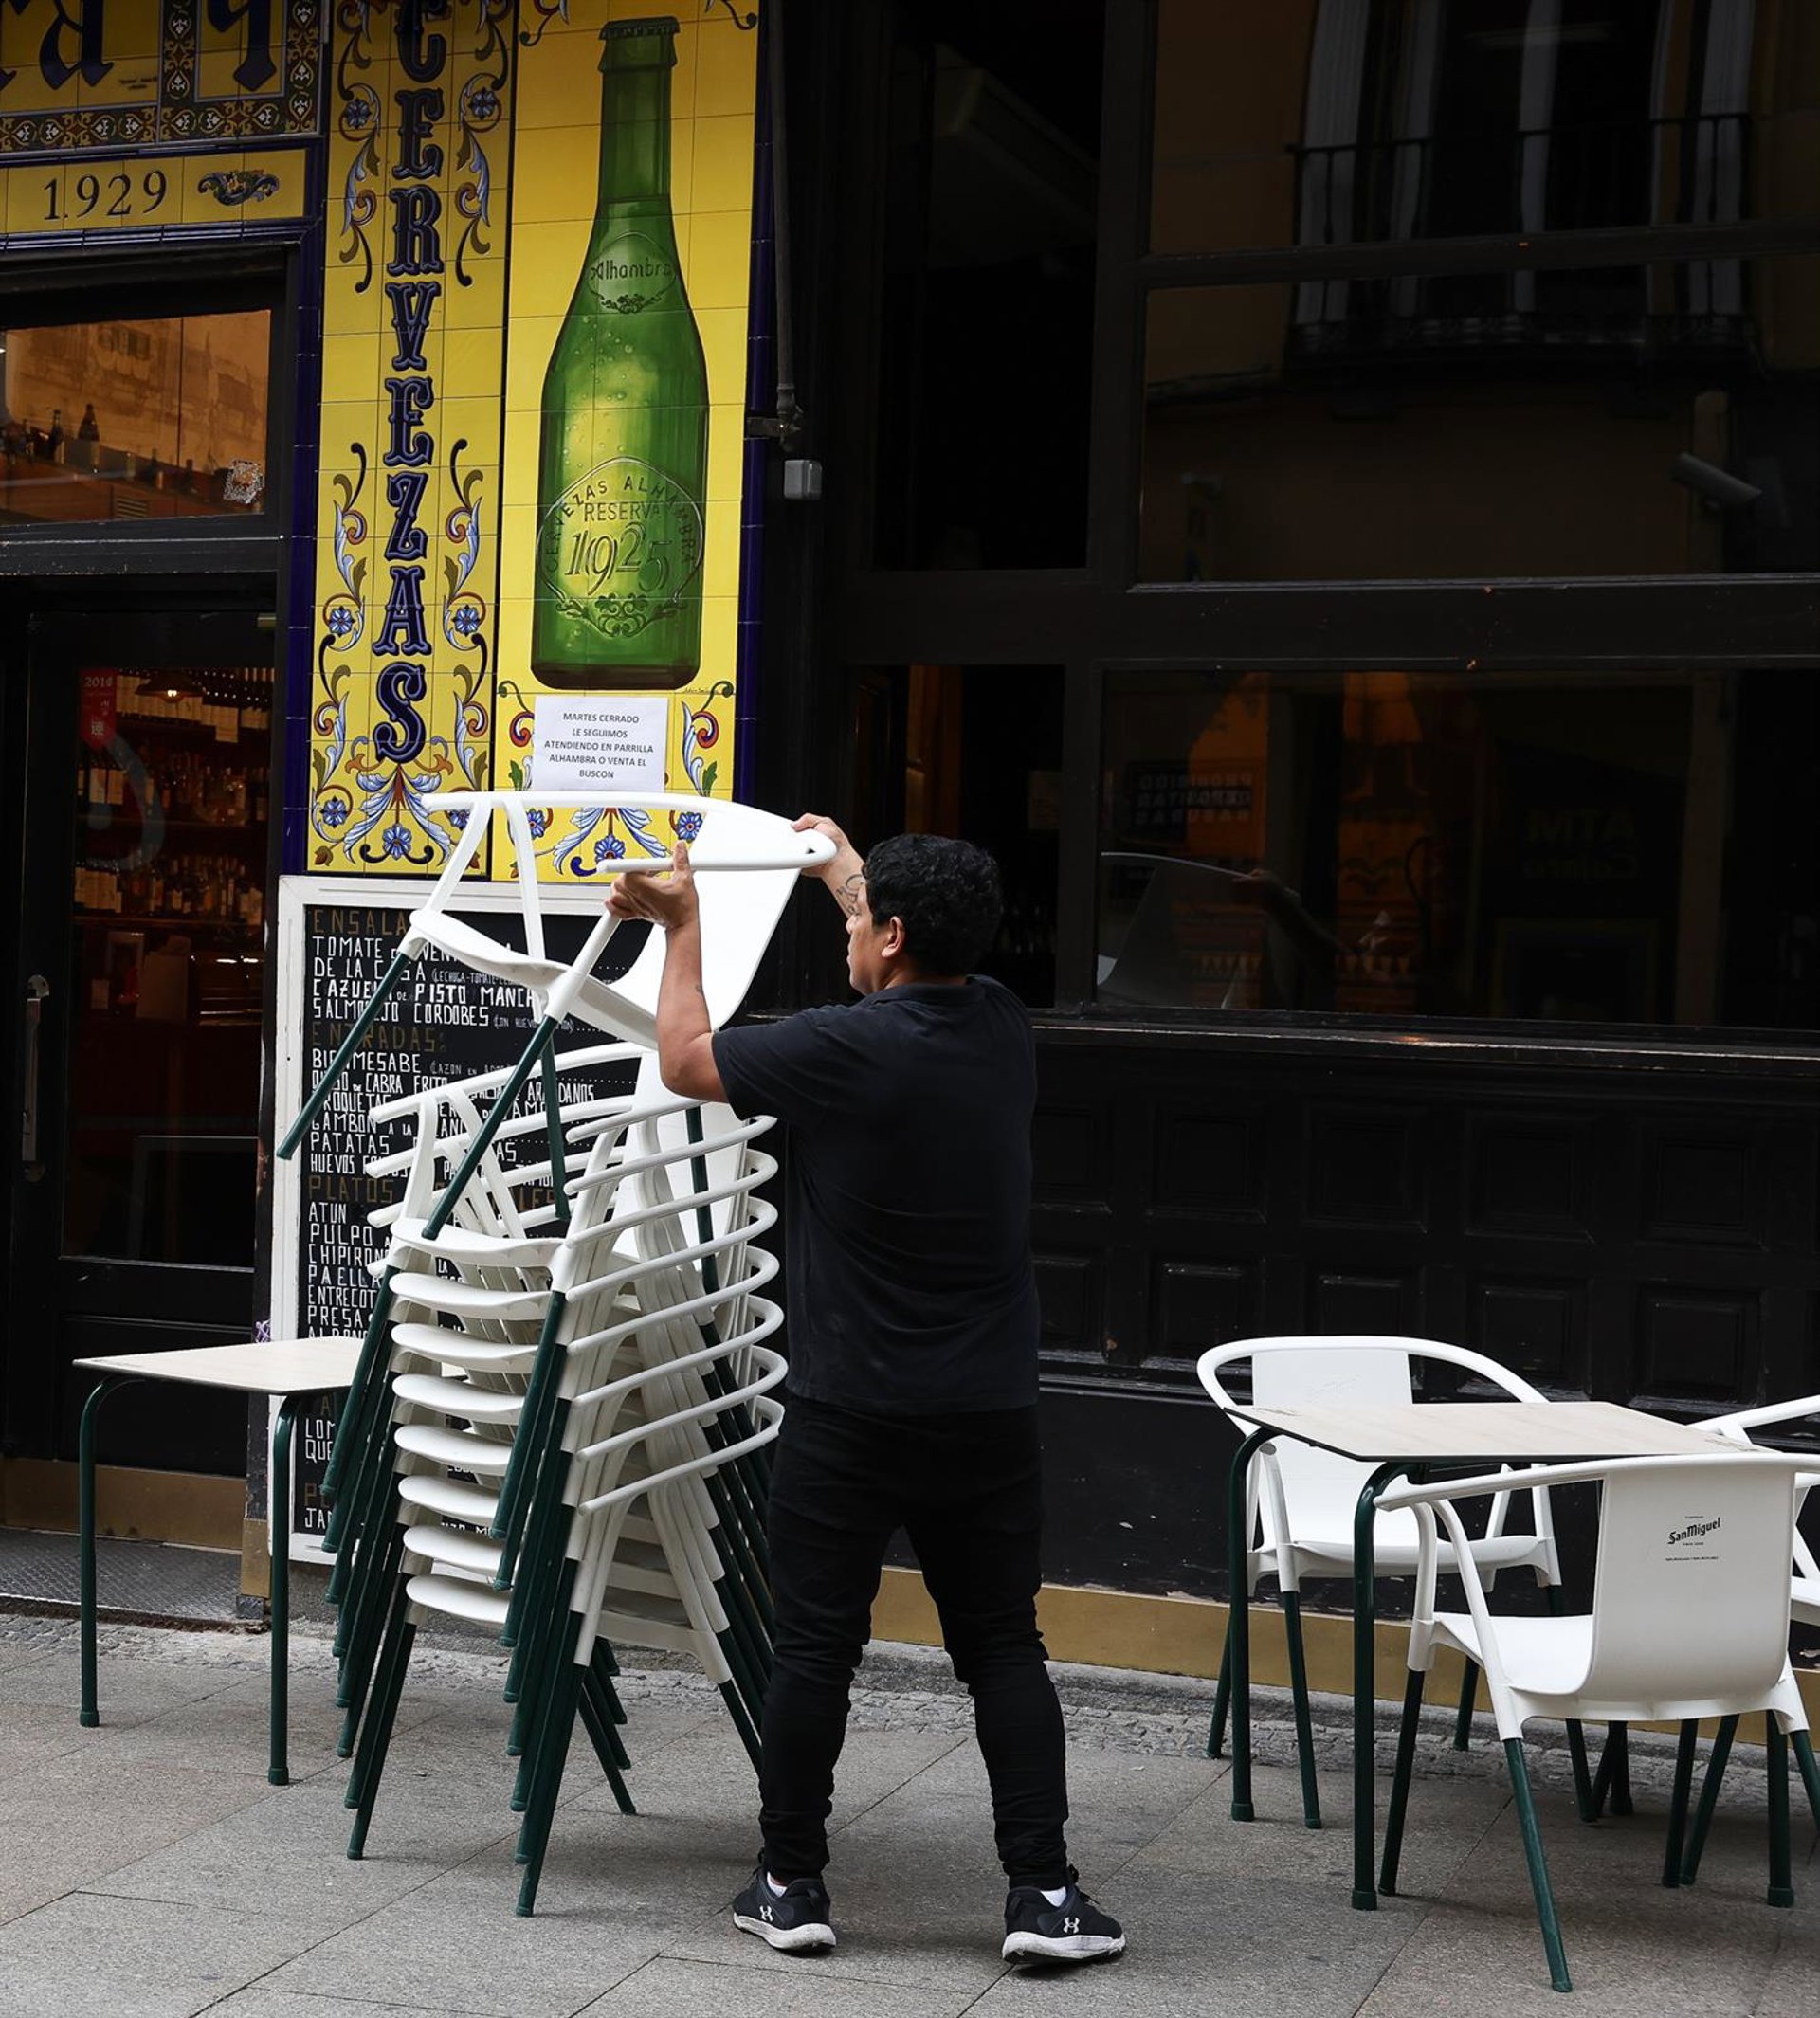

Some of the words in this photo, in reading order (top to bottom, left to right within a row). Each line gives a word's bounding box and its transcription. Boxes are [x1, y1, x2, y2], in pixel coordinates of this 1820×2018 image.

[373, 0, 446, 763] CERVEZAS
[583, 501, 664, 522] RESERVA
[564, 521, 673, 596] 1925
[563, 712, 598, 722] MARTES
[599, 714, 640, 724] CERRADO
[572, 728, 581, 736] LE
[583, 728, 628, 738] SEGUIMOS
[544, 740, 599, 751] ATENDIENDO
[601, 742, 612, 752] EN
[614, 743, 654, 754] PARRILLA
[549, 754, 597, 764] ALHAMBRA
[598, 756, 607, 765] O
[608, 756, 636, 766] VENTA
[637, 758, 646, 767] EL
[579, 769, 615, 779] BUSCON
[312, 936, 384, 959] TOMATE
[314, 957, 336, 977] DE
[346, 959, 363, 979] LA
[374, 959, 426, 982] CSA
[313, 979, 392, 1001] CAZUE
[396, 991, 408, 1001] DE
[415, 983, 466, 1004] PISTO
[313, 997, 399, 1023] SALMOJO
[414, 1002, 489, 1027] CORDOBES
[312, 1048, 422, 1074] BIMESABE
[366, 1073, 404, 1095] CABRA
[528, 1082, 595, 1104] ARDANOS
[388, 1122, 395, 1136] A
[402, 1123, 413, 1136] LA
[310, 1131, 390, 1155] PATATAS
[311, 1153, 355, 1174] HUEVOS
[309, 1174, 393, 1203] PLATOS
[308, 1201, 347, 1224] ATUN
[310, 1223, 373, 1246] PULPO
[308, 1284, 378, 1309] ENTRECOT
[307, 1305, 364, 1329] PRESA
